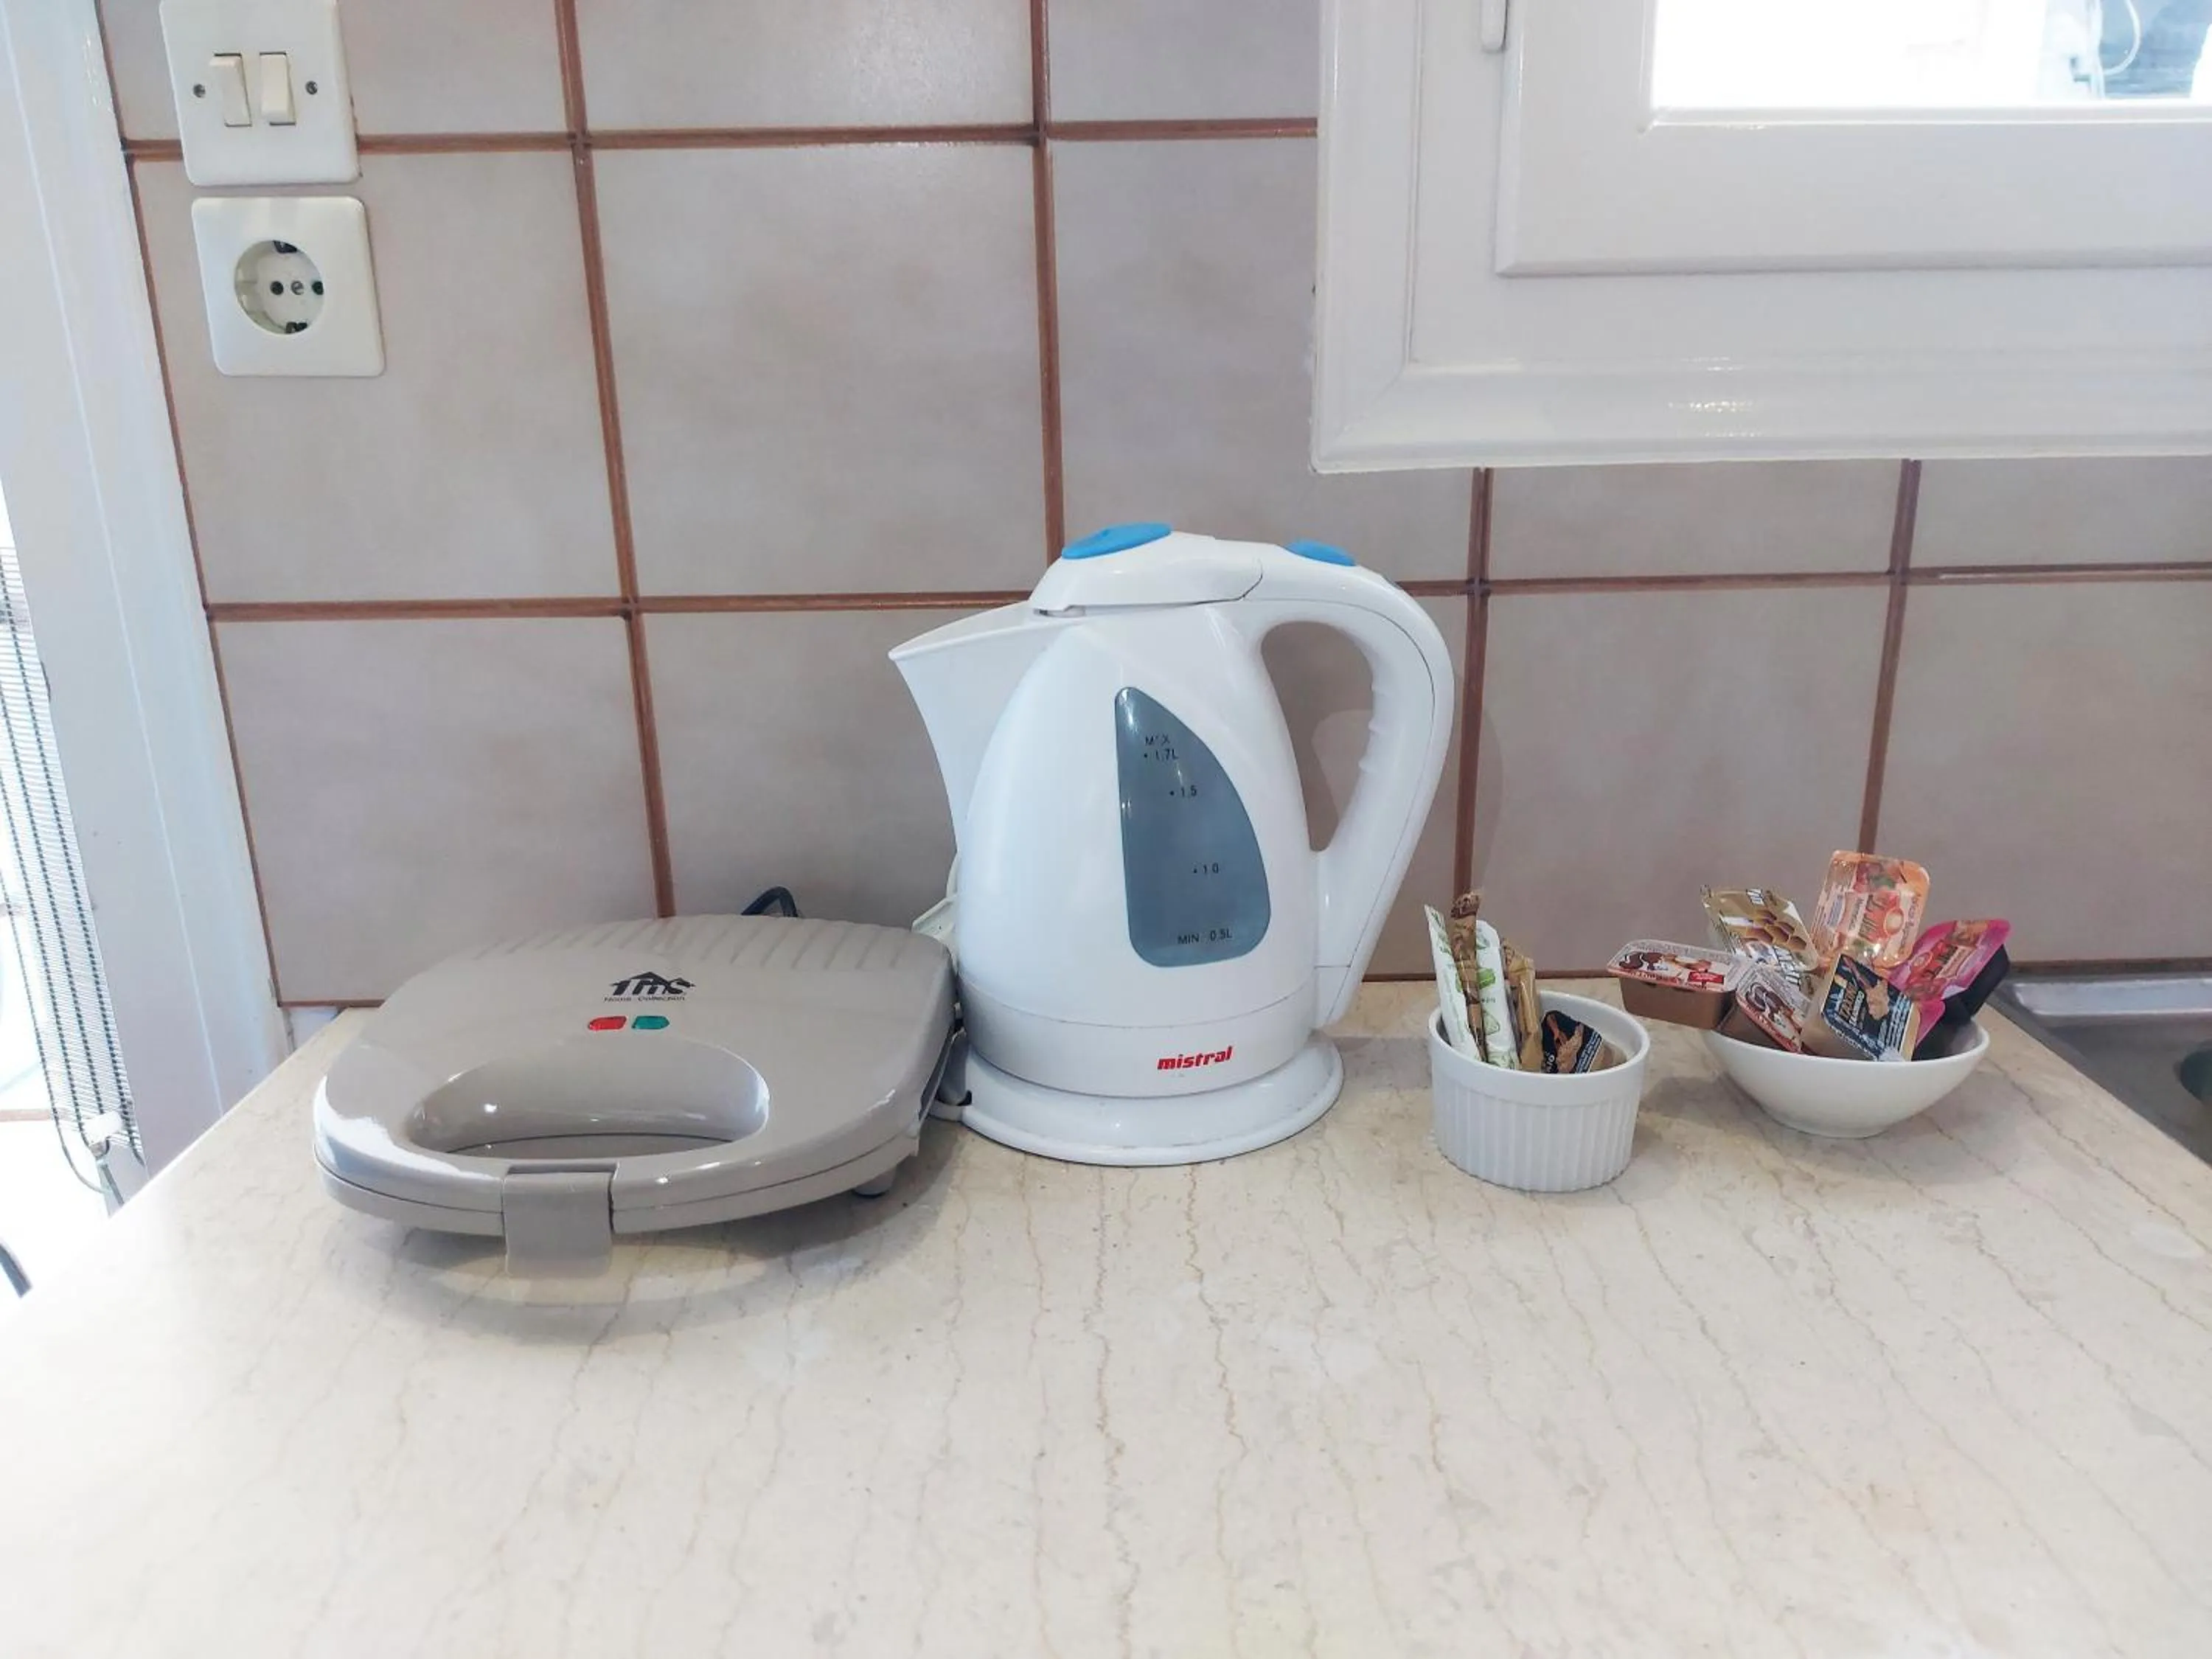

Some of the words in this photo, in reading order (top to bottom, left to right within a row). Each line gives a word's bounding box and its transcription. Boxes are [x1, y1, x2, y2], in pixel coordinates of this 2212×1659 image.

[1144, 734, 1171, 746] MX
[1178, 933, 1200, 945] MIN
[1157, 1045, 1233, 1070] mistral
